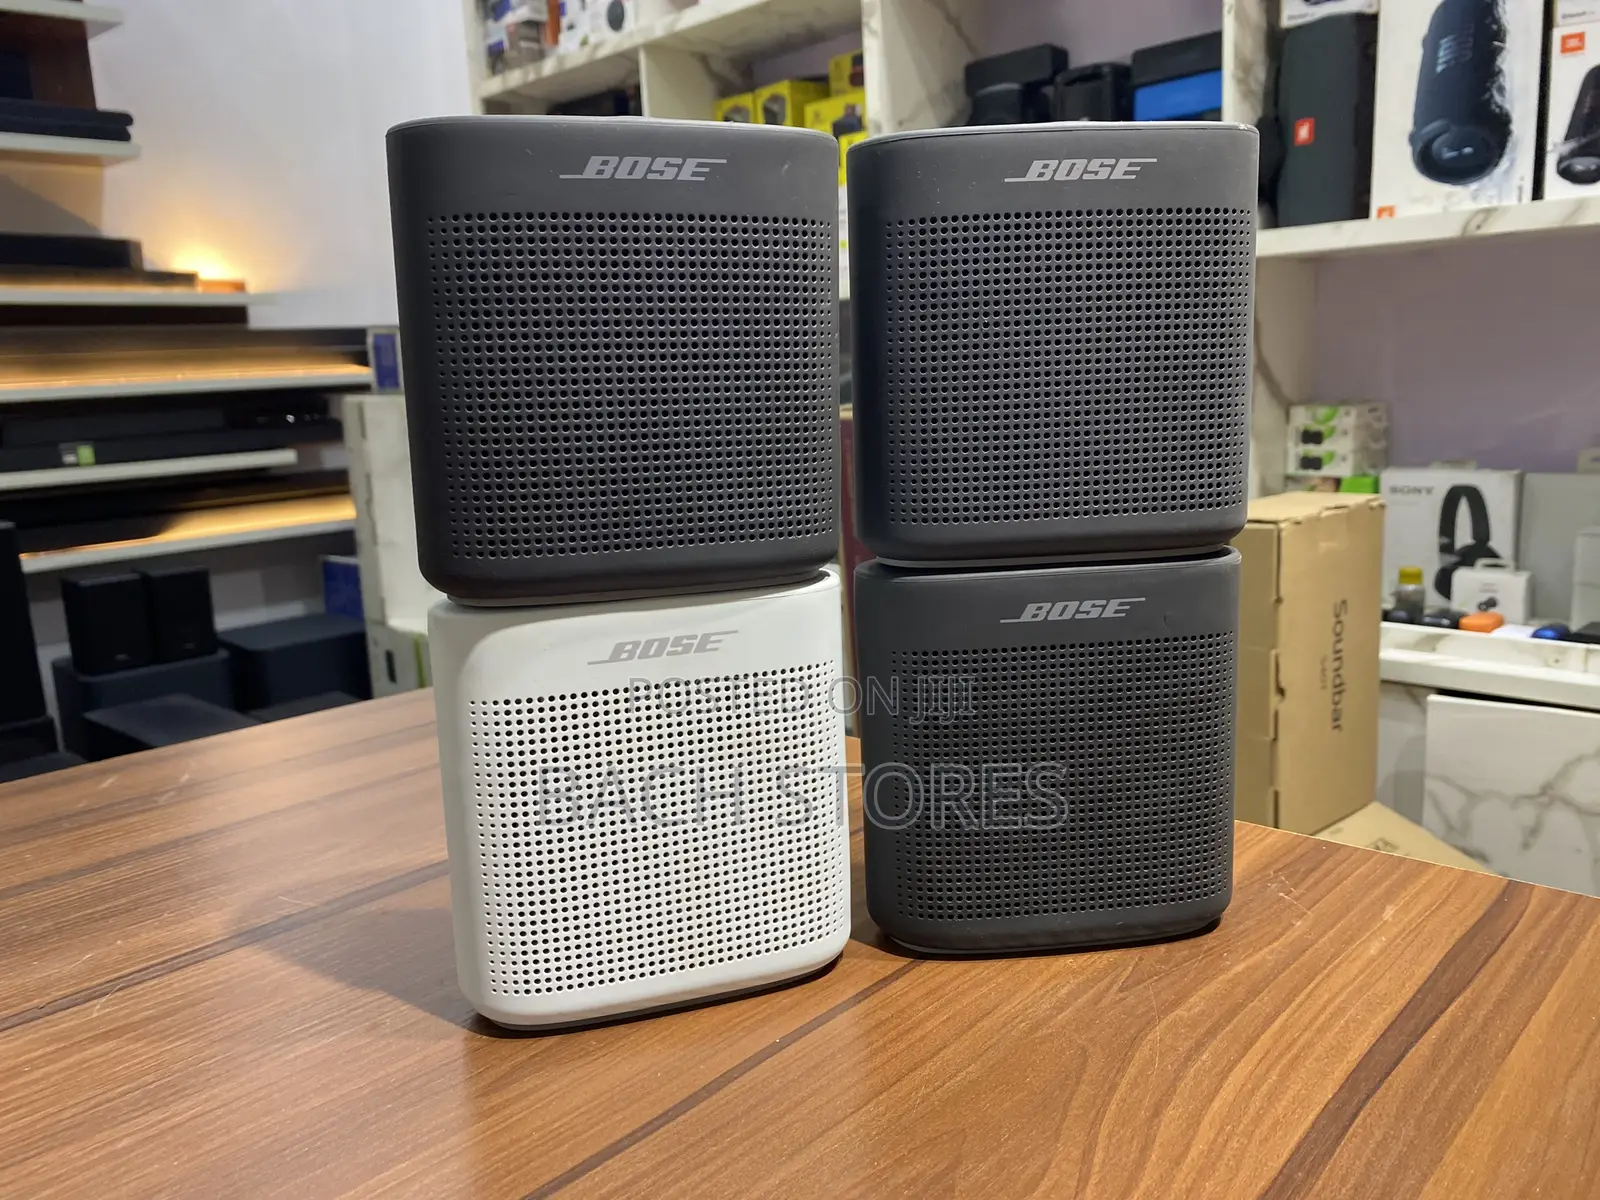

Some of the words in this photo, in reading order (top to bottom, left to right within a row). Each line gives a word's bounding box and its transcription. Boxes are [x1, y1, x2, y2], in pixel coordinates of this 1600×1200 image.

[559, 156, 727, 181] BOSE
[1004, 158, 1157, 182] BOSE
[1000, 597, 1146, 623] BOSE
[587, 630, 738, 665] BOSE
[1331, 599, 1348, 732] Soundbar
